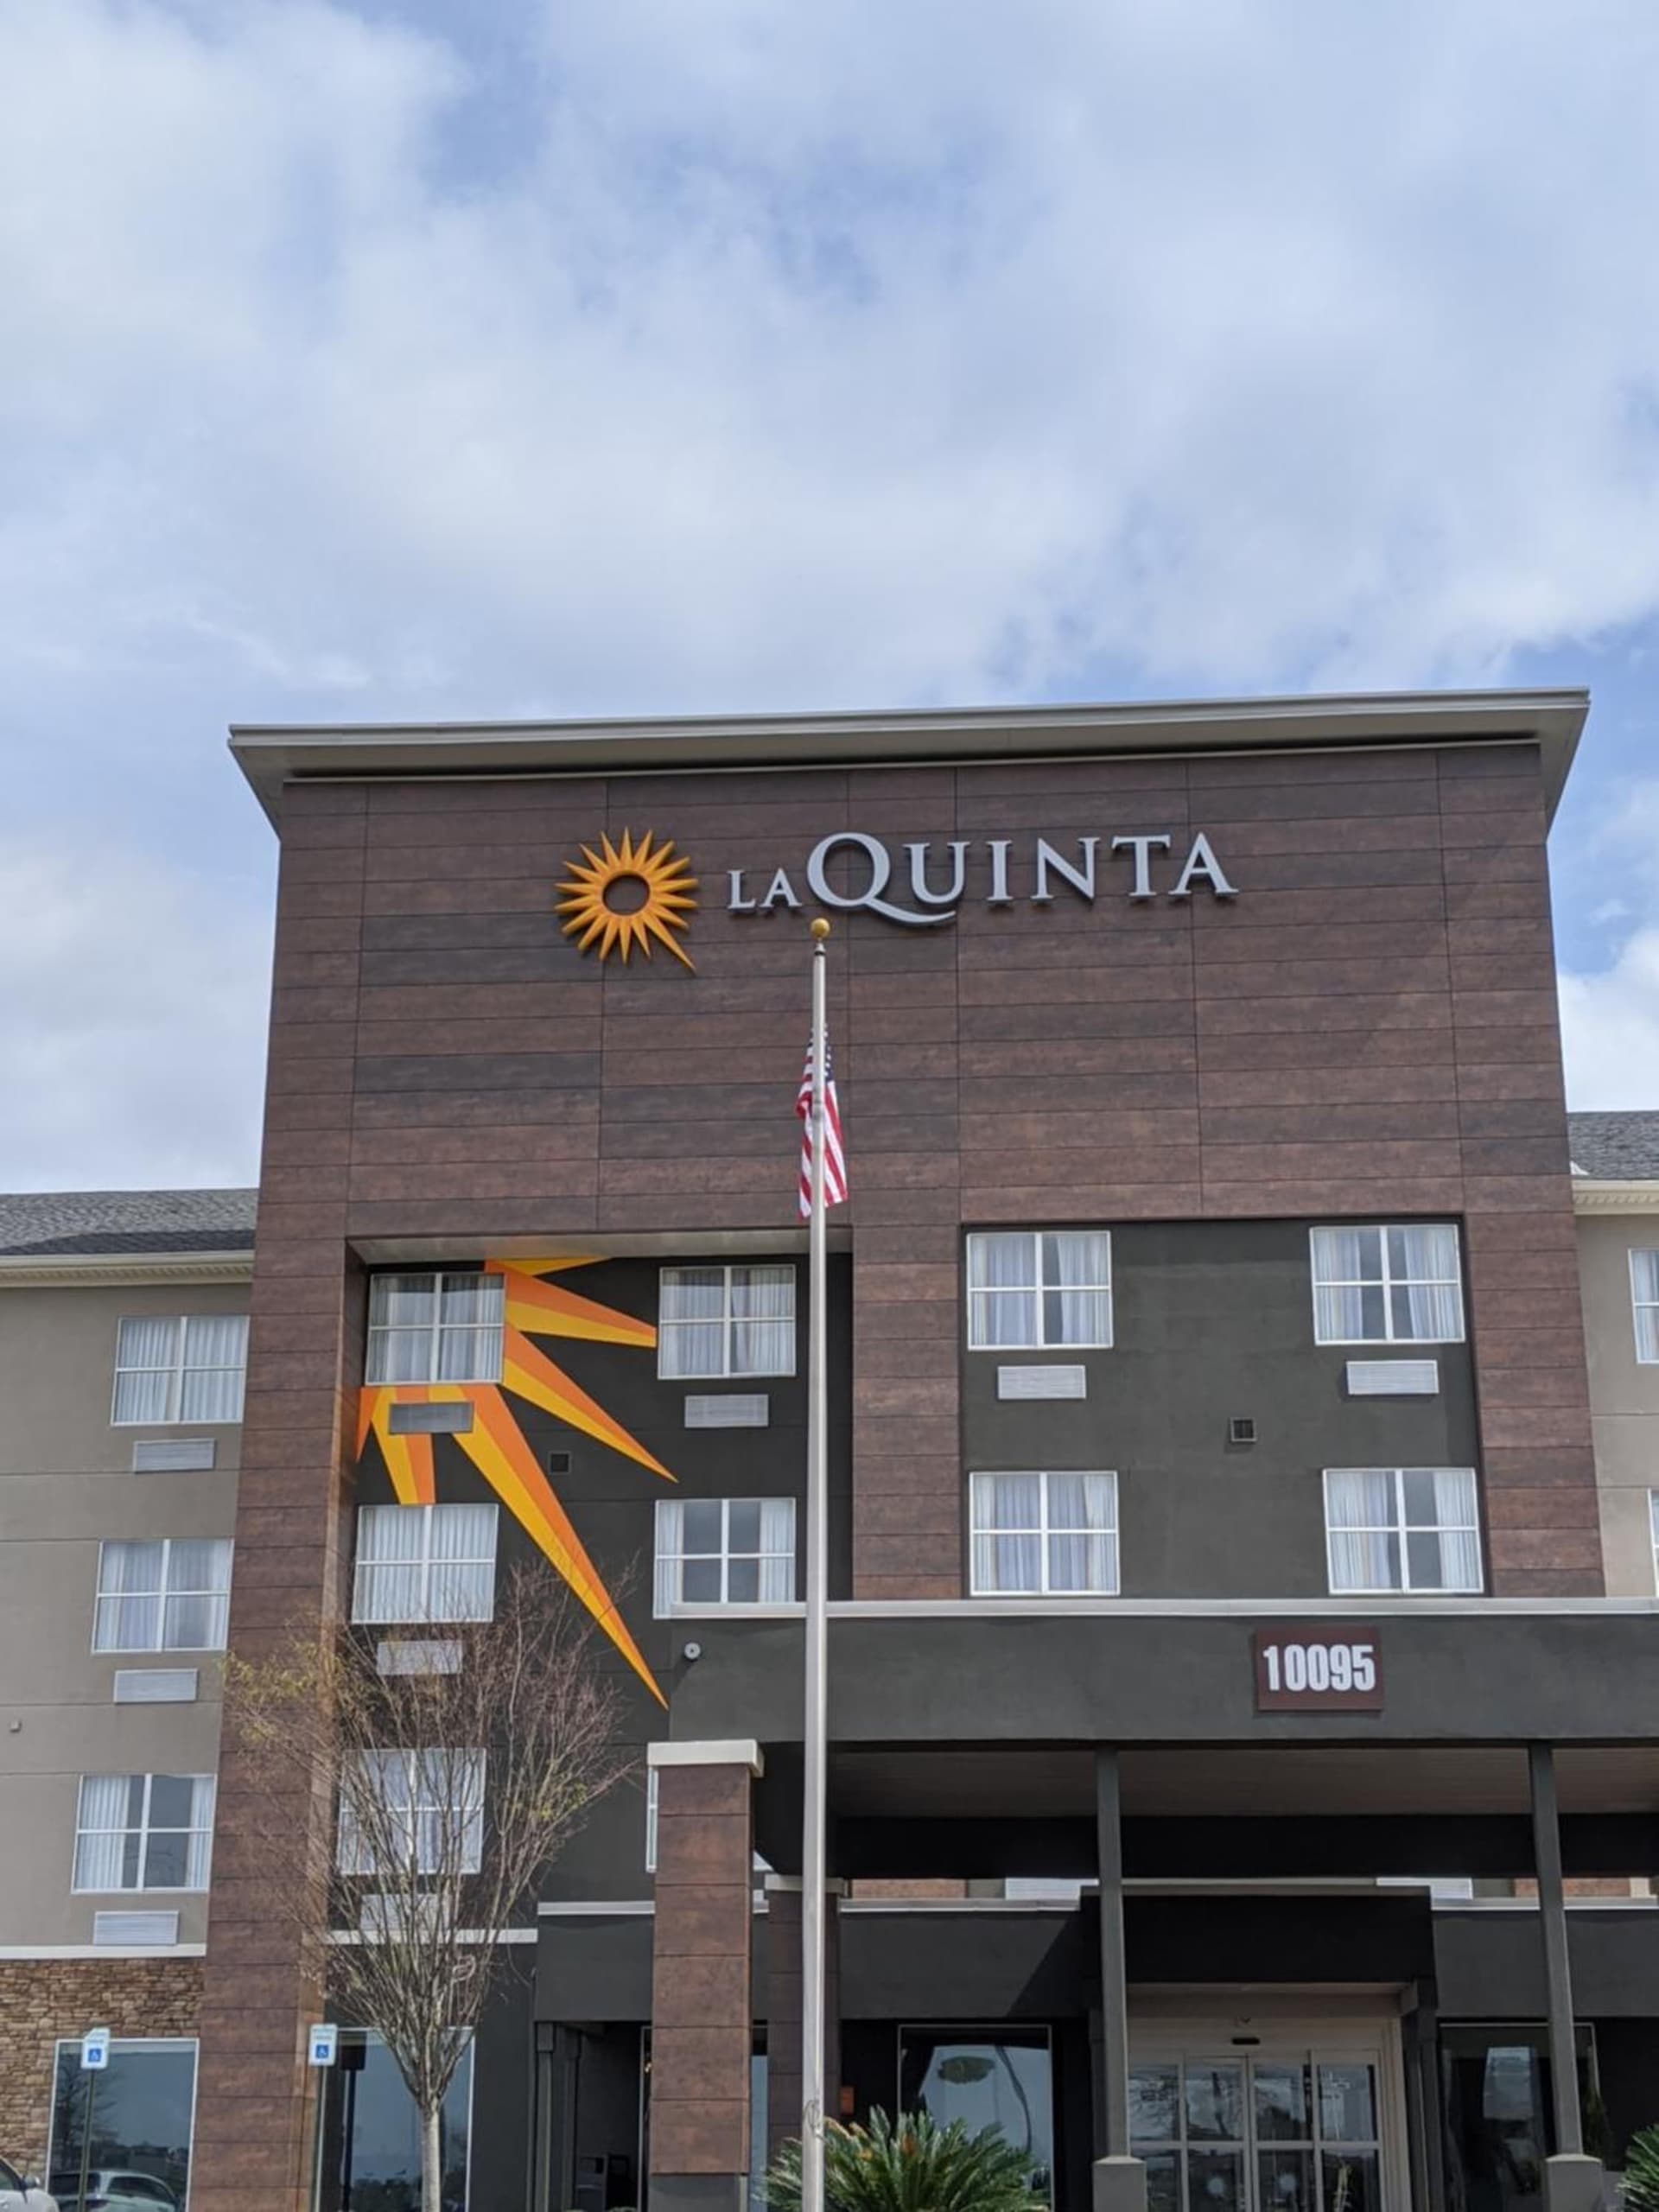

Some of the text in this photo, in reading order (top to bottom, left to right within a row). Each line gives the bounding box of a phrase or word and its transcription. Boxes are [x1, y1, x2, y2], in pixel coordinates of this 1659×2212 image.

[727, 831, 1239, 924] LA QUINTA
[1262, 1643, 1376, 1692] 10095
